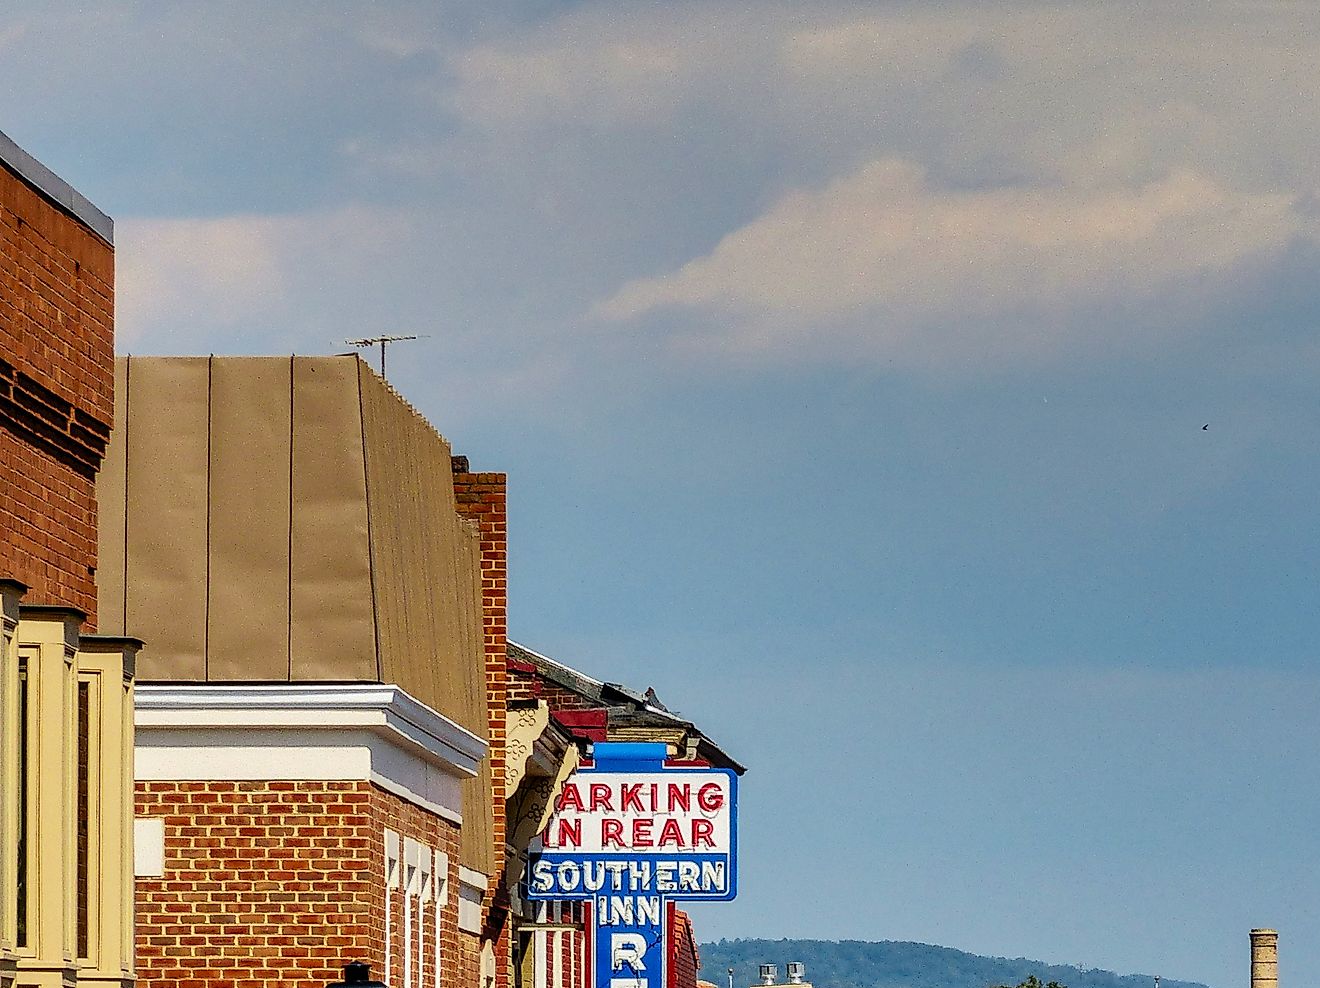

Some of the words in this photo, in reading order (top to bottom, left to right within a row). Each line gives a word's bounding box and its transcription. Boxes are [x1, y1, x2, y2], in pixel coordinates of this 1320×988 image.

[557, 783, 724, 812] ARKING
[602, 819, 716, 847] REAR
[532, 860, 726, 891] SOUTHERN
[597, 898, 660, 926] INN
